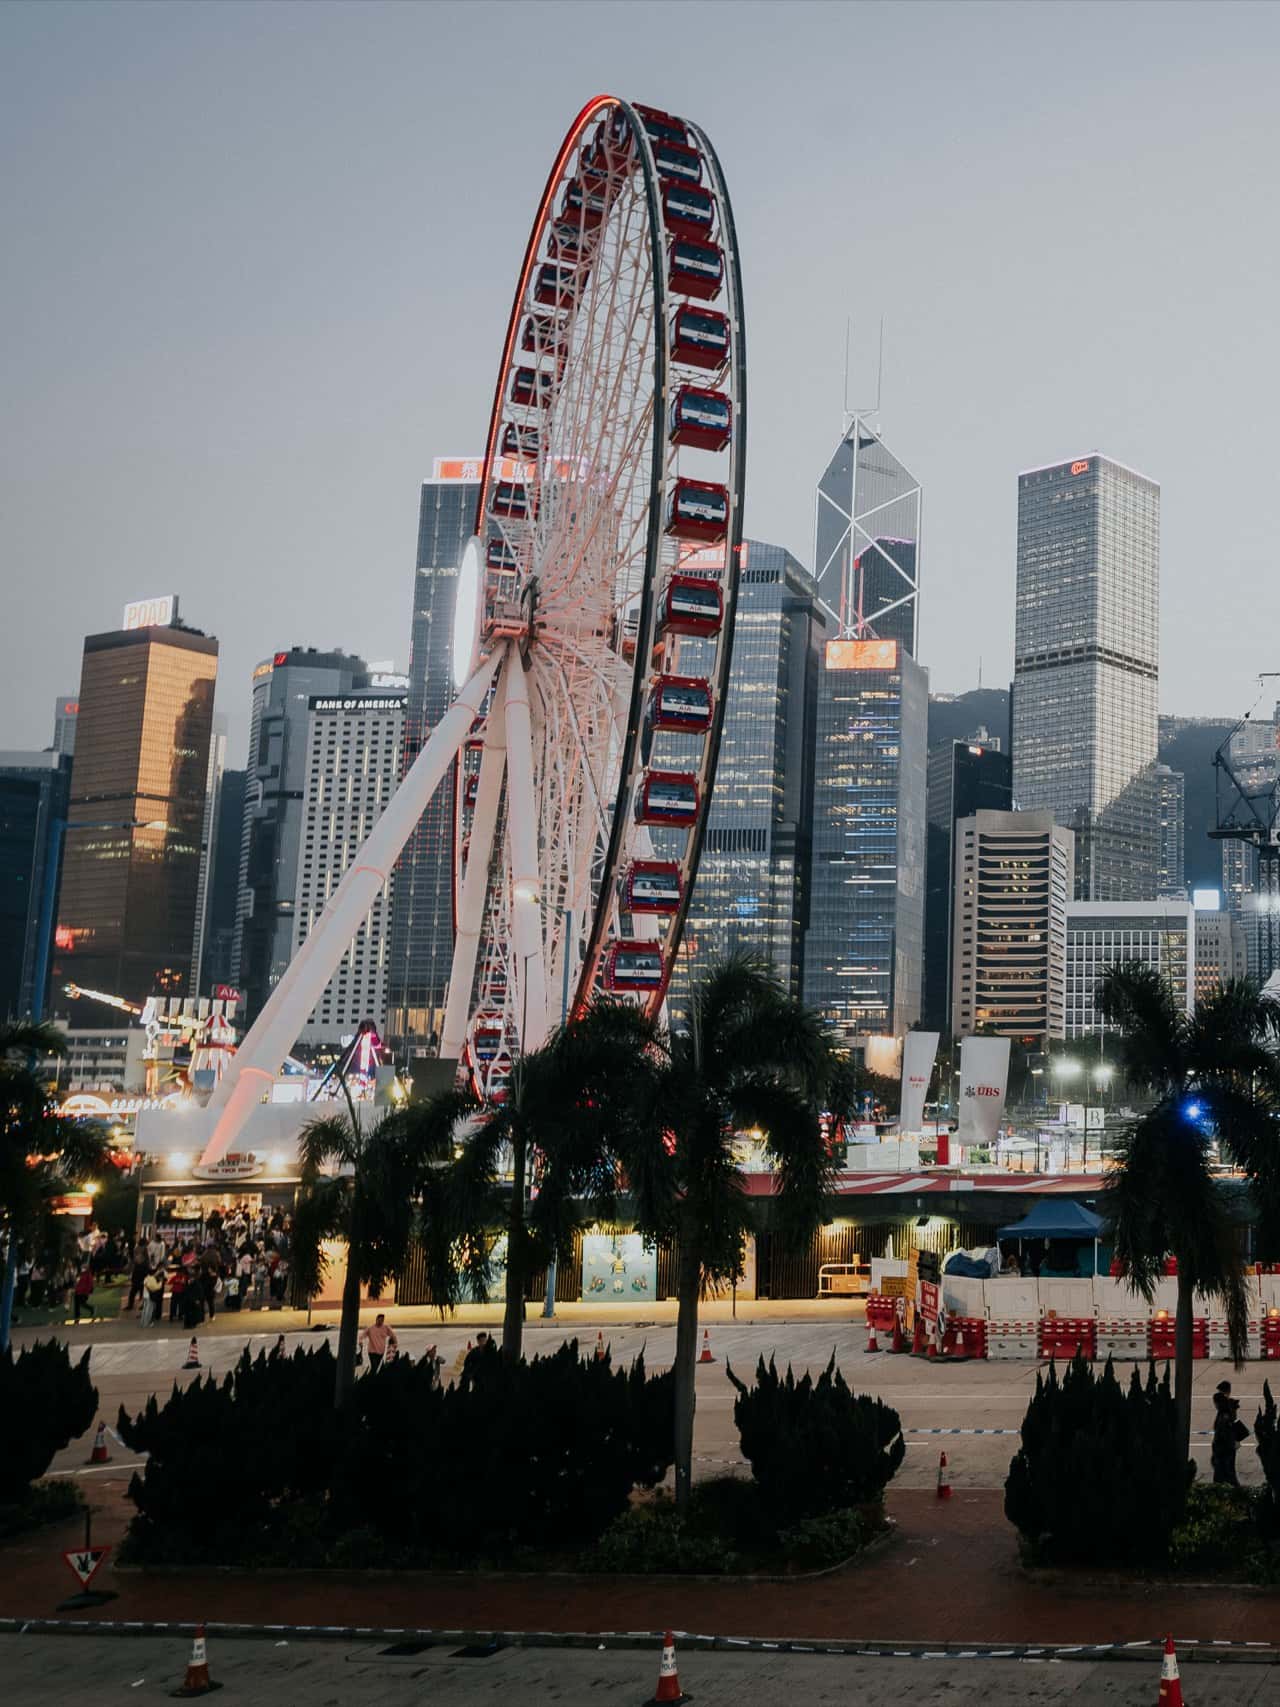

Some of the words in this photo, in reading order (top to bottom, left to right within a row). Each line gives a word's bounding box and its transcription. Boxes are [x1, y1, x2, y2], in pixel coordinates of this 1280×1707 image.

[316, 700, 342, 709] BANK
[344, 700, 356, 709] OF
[357, 700, 401, 709] AMERICA
[220, 989, 241, 998] AIA
[977, 1086, 1000, 1097] UBS
